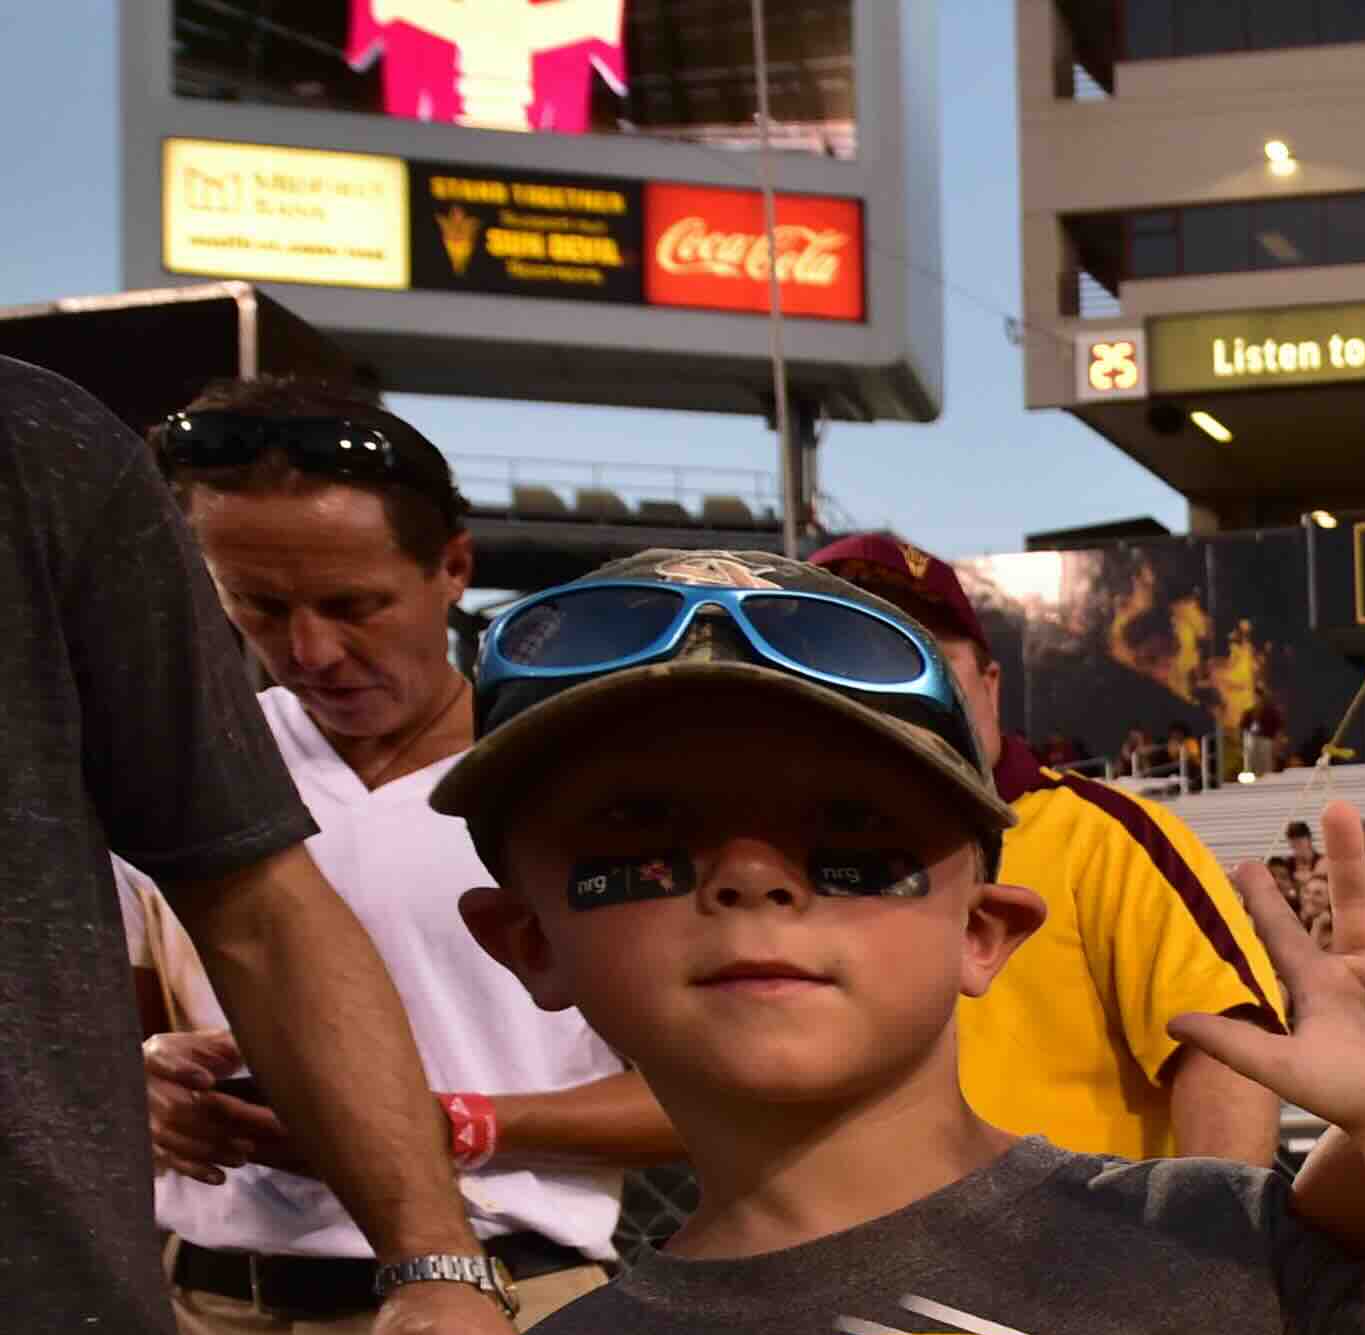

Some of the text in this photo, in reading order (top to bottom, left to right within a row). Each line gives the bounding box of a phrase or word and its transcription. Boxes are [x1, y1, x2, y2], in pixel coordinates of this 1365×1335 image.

[1212, 336, 1321, 376] Listen
[576, 873, 608, 896] nrg
[822, 864, 861, 884] nrg
